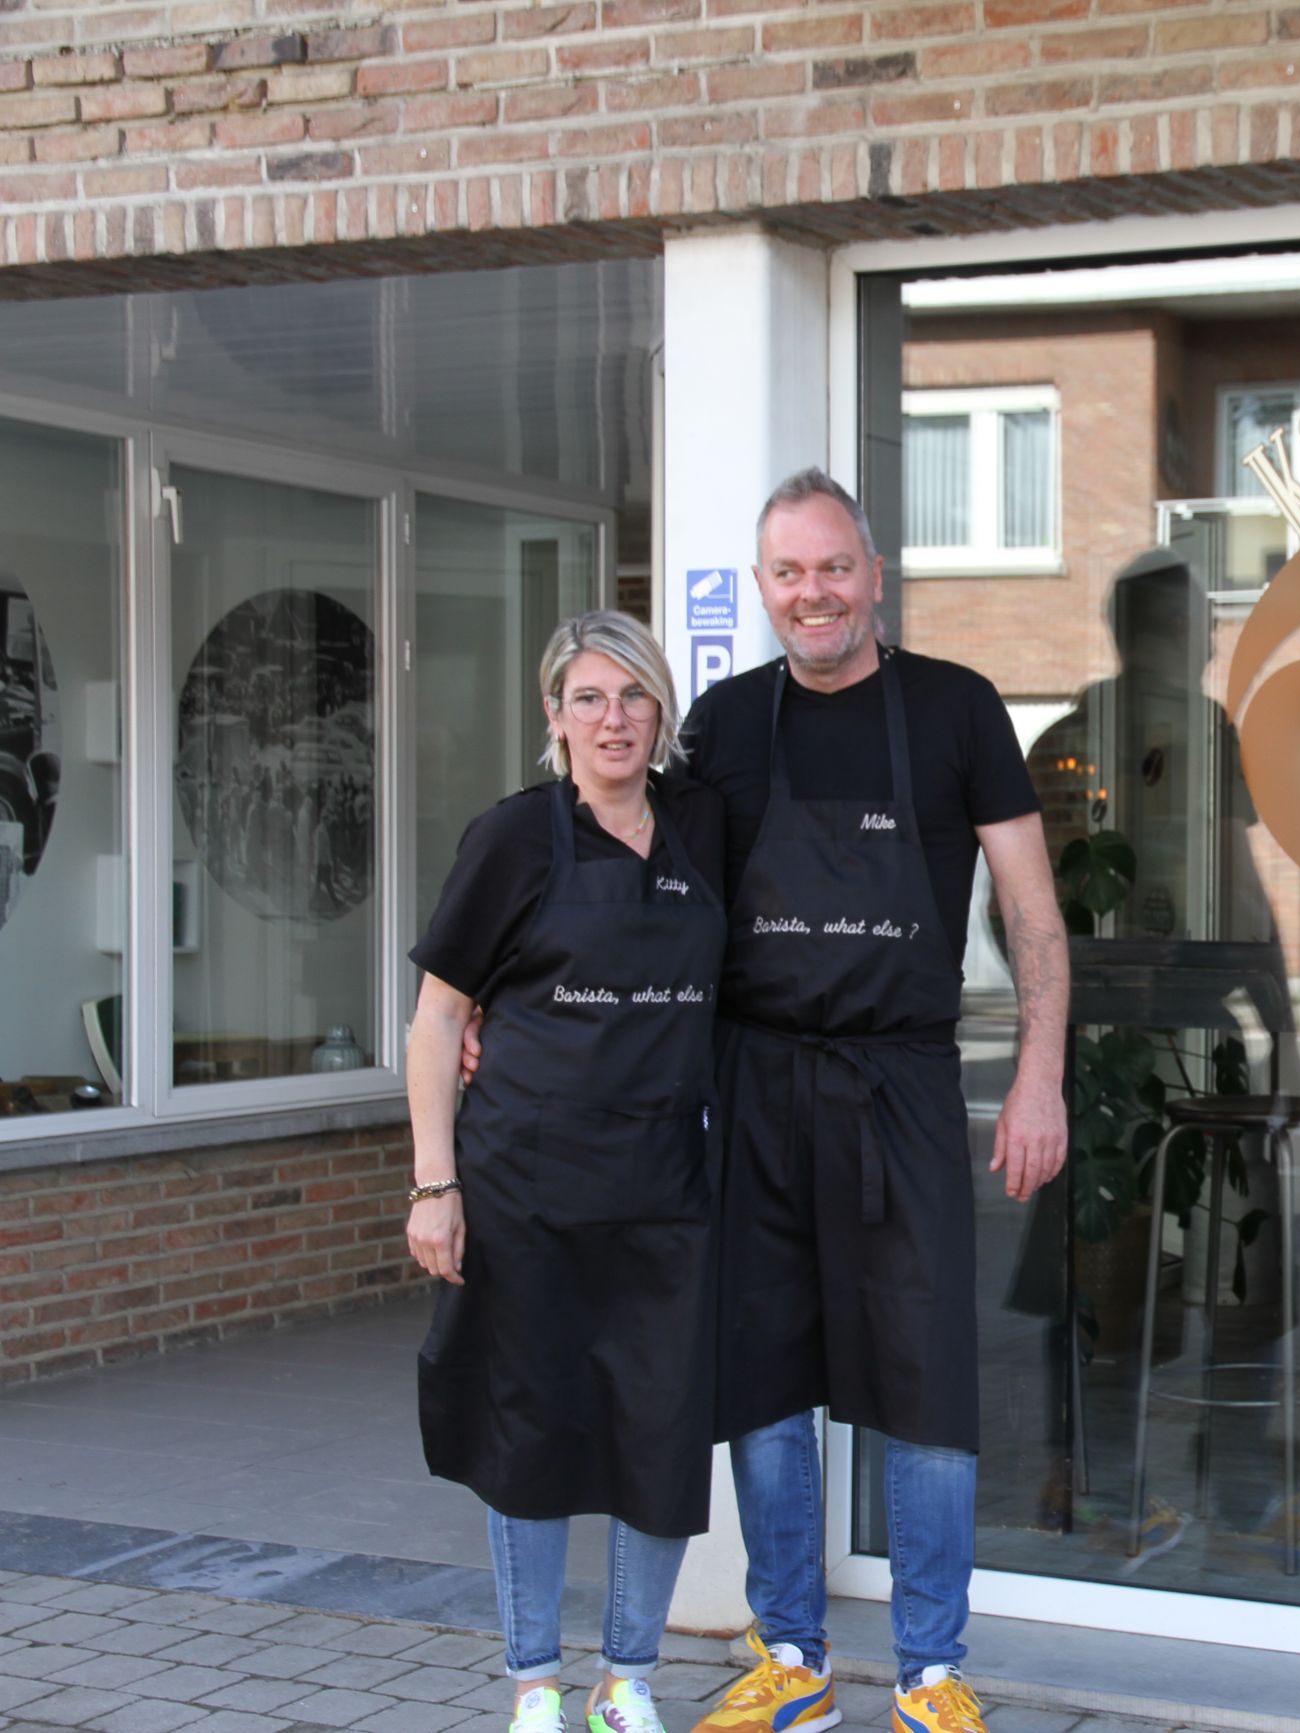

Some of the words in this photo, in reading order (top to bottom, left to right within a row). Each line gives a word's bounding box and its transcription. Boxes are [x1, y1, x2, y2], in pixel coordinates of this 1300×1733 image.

[696, 645, 731, 698] P
[860, 813, 896, 830] Mike
[753, 916, 811, 934] Barista,
[823, 917, 866, 934] what
[872, 919, 902, 938] else
[909, 923, 920, 940] ?
[553, 984, 620, 1005] Barista,
[632, 984, 672, 1004] what
[676, 984, 704, 1003] else
